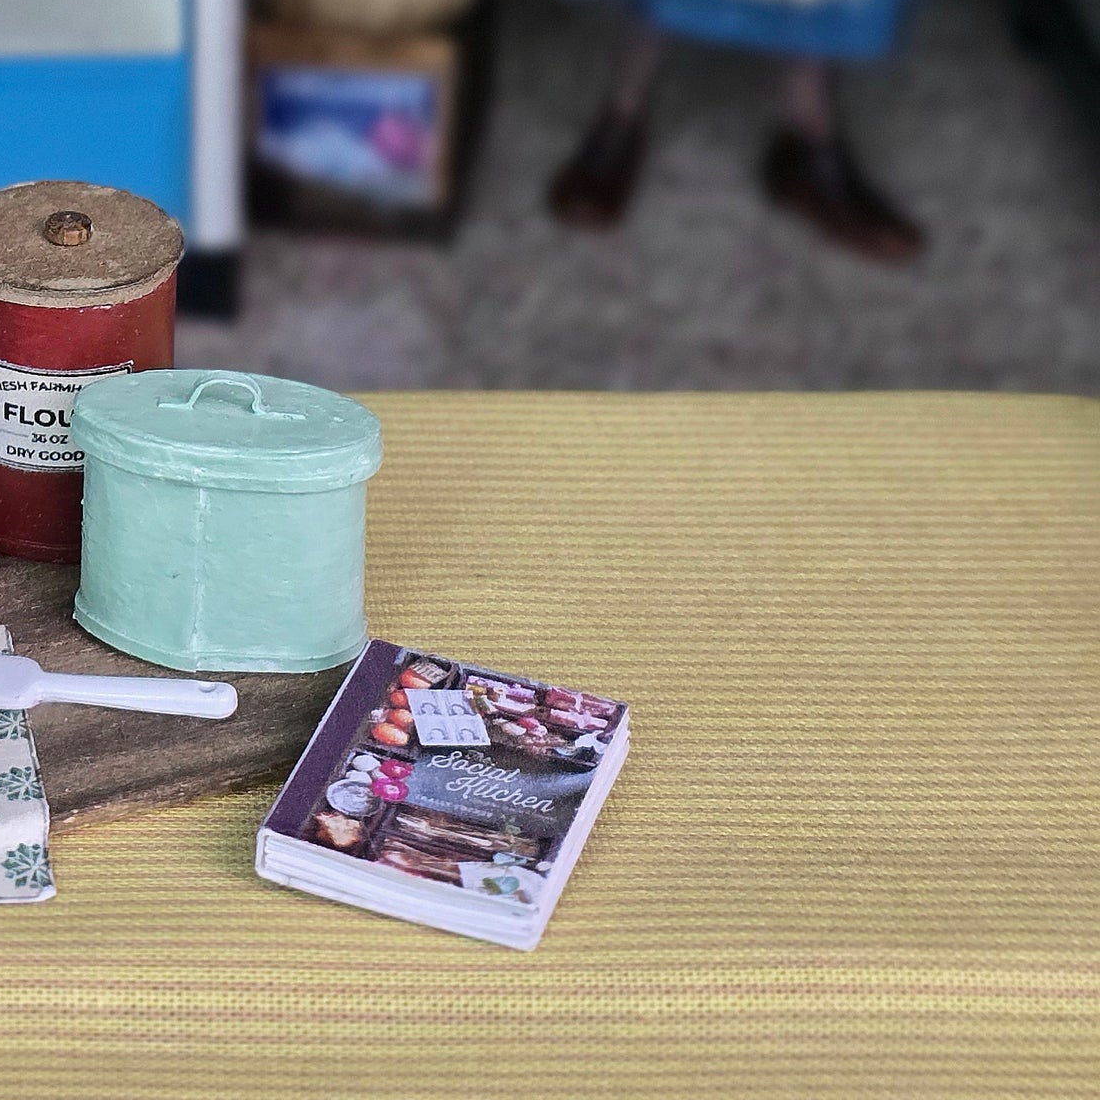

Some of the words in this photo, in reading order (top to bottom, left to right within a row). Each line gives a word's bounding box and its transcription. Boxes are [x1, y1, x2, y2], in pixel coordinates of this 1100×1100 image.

[30, 382, 83, 393] FARMH
[4, 402, 75, 428] FLOU
[49, 434, 68, 444] OZ
[6, 445, 35, 459] DRY
[38, 451, 85, 461] GOOD
[427, 751, 520, 783] Social
[446, 775, 555, 813] Kitchen
